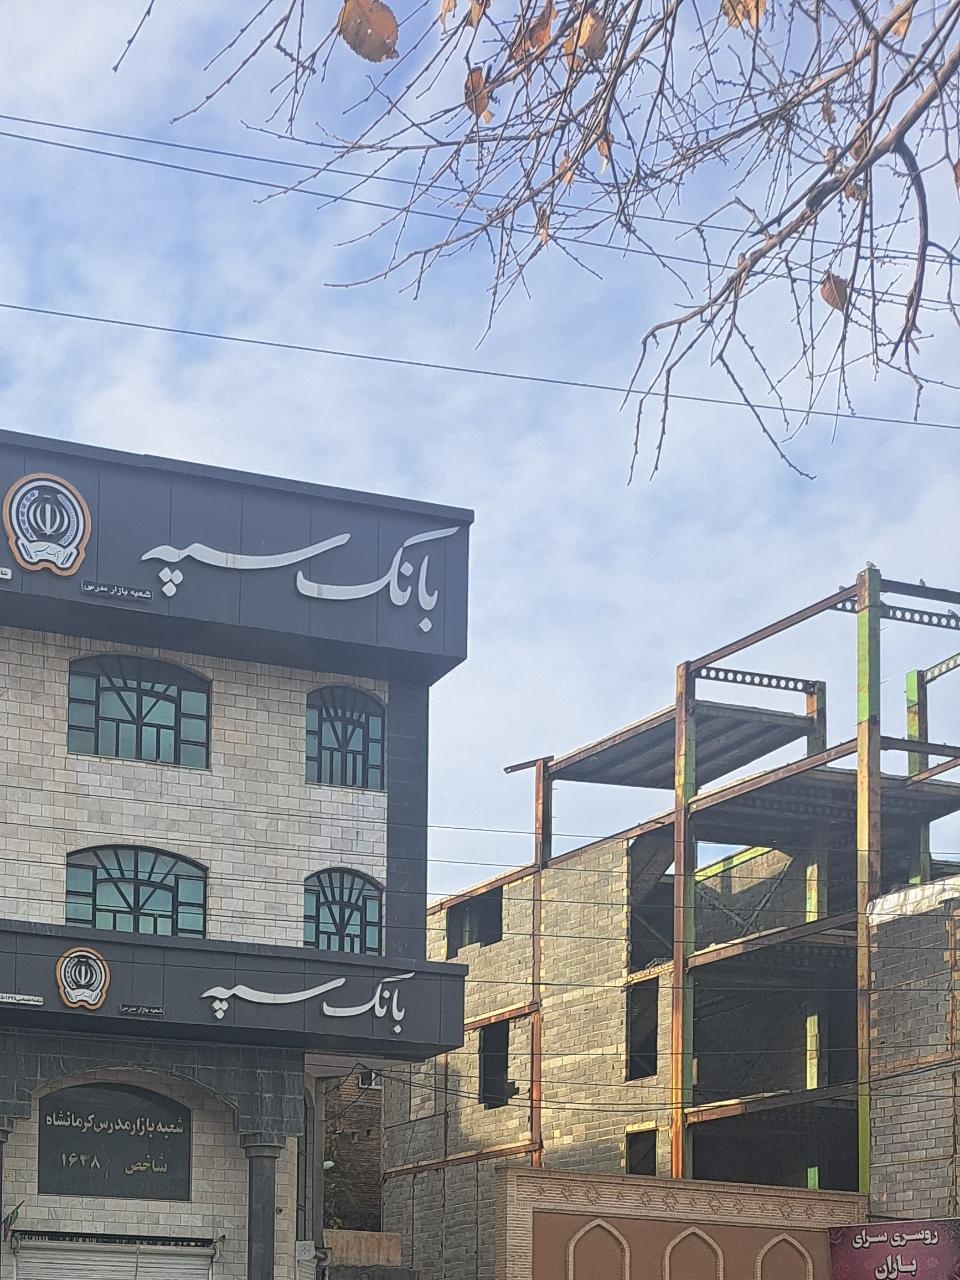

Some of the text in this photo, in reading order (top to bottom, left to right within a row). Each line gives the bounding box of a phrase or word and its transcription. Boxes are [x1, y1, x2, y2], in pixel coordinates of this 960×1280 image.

[83, 584, 152, 598] شعبه بازار مدرس
[141, 526, 460, 633] بانک سپه
[200, 971, 416, 1034] بانک سپه
[46, 1109, 184, 1139] شعبه بازار مدرس کرمانشاه
[125, 1153, 168, 1174] شاخص
[852, 1229, 939, 1248] روسری سرای
[875, 1254, 917, 1280] باران
